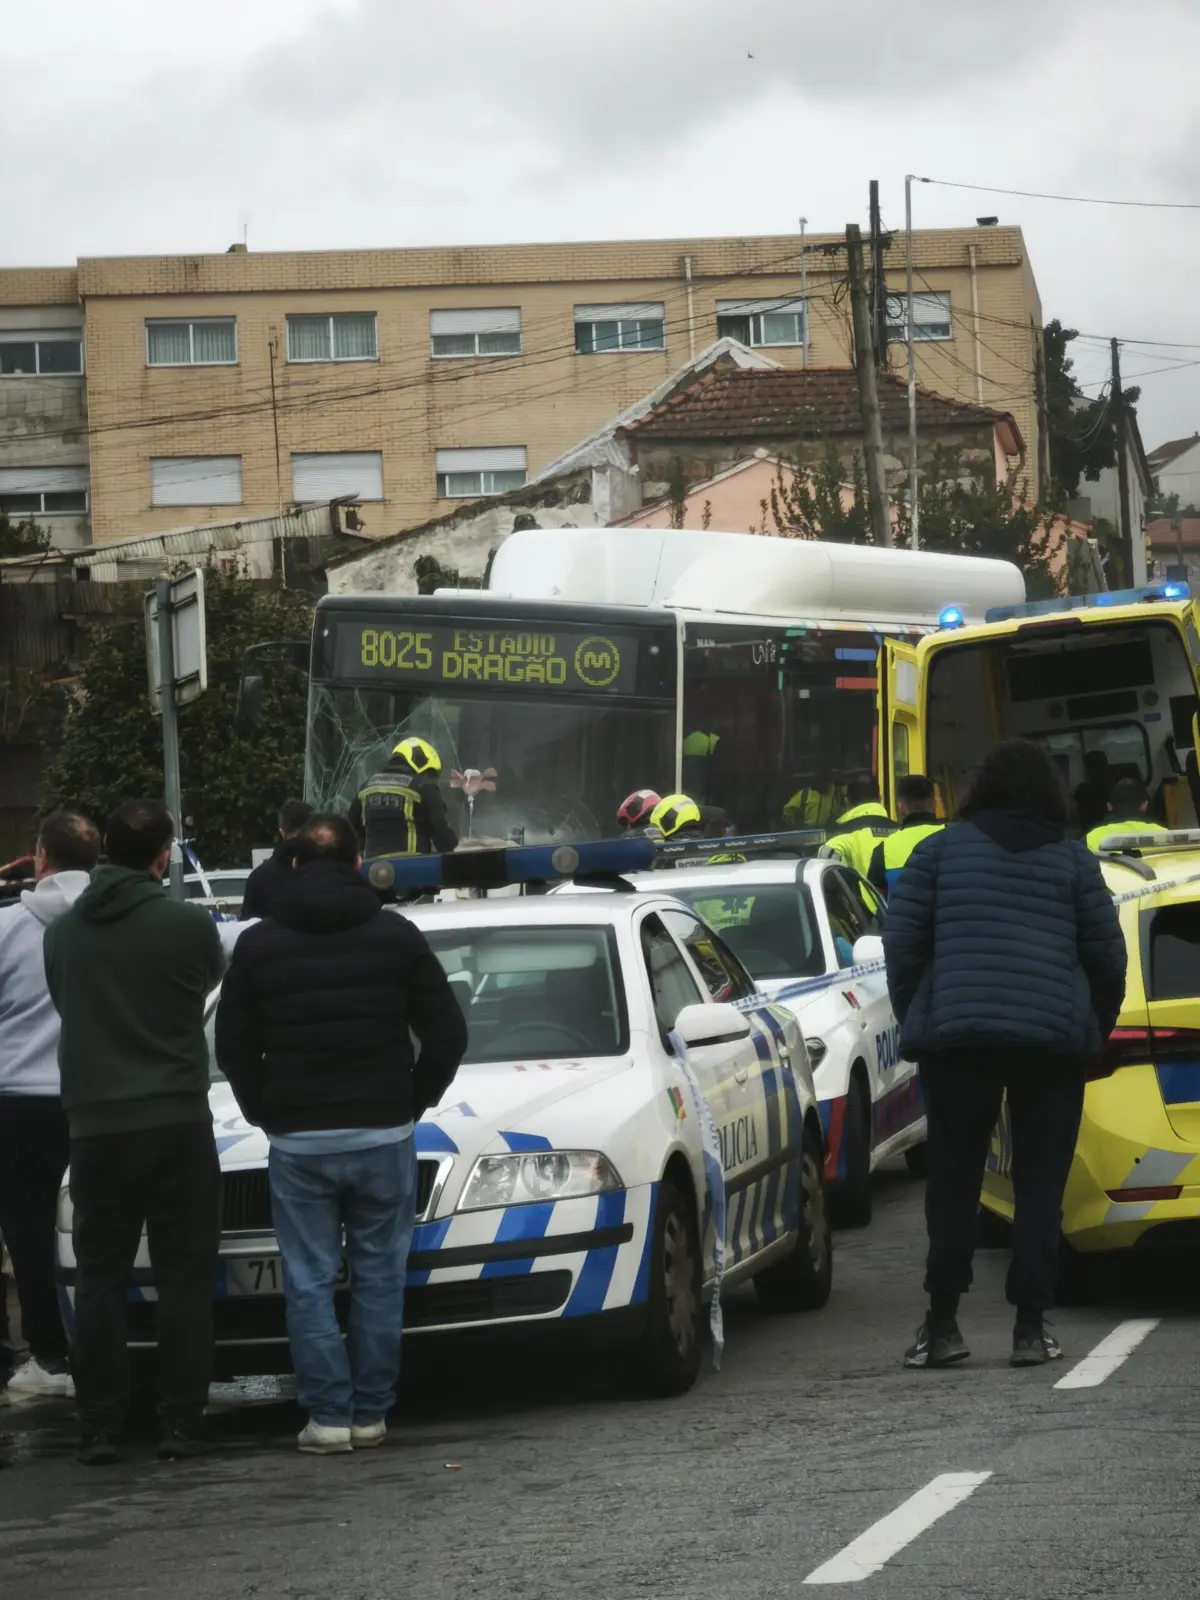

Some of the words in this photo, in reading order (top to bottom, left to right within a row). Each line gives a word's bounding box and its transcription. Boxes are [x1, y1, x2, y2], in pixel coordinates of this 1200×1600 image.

[361, 630, 433, 670] 8025
[454, 629, 556, 655] ESTÁDIO
[442, 652, 567, 684] DRAGÃO
[716, 1114, 758, 1172] OLICIA
[247, 1260, 277, 1290] 71
